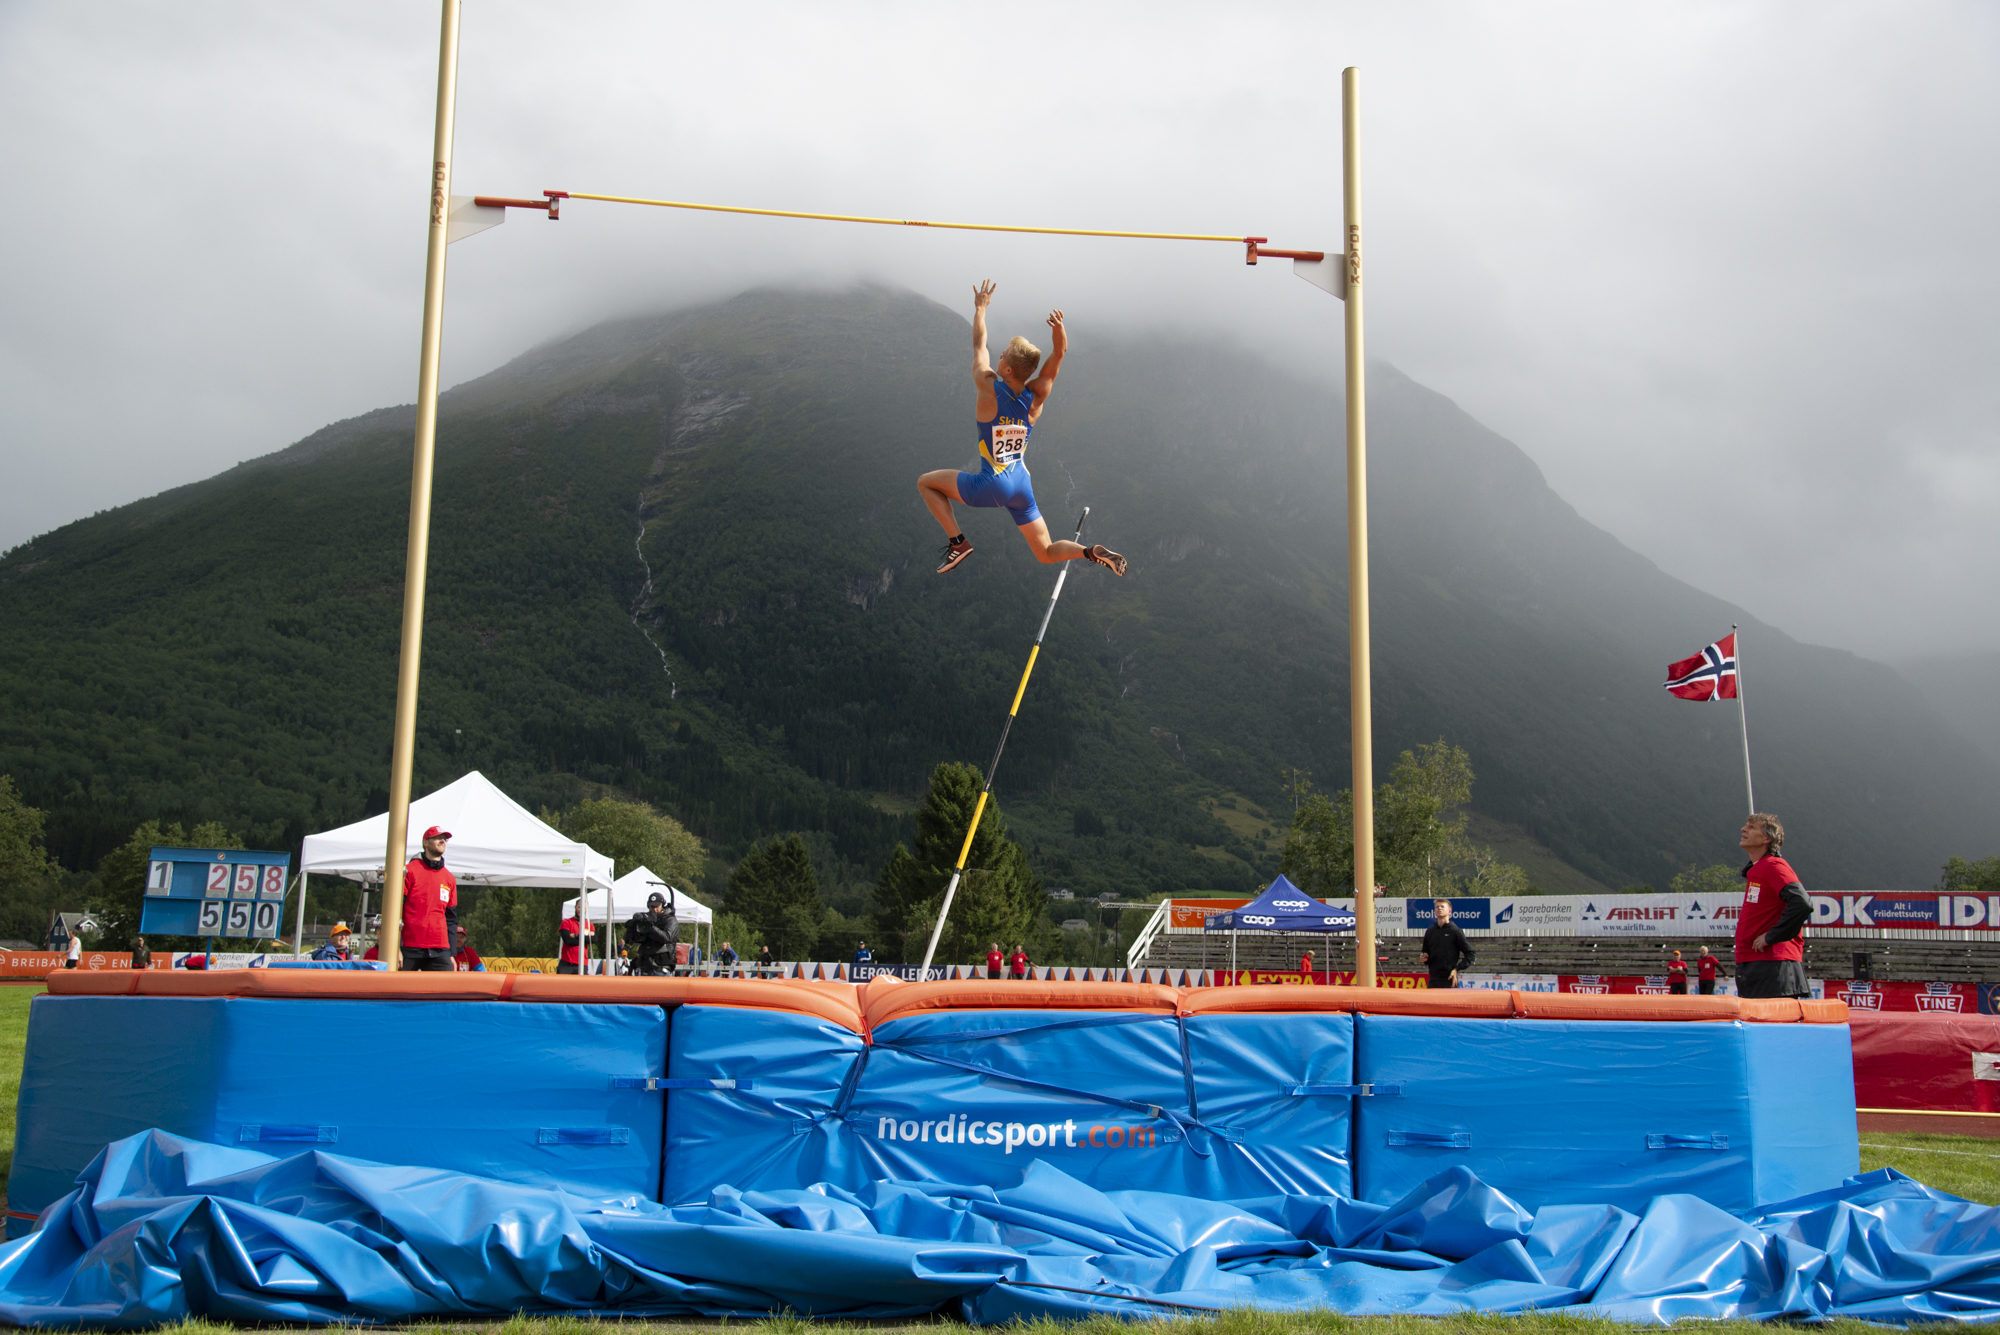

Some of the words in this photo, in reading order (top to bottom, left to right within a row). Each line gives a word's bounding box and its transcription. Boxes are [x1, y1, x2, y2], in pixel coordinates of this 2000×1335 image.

[995, 438, 1023, 455] 258
[154, 862, 169, 889] 1
[209, 865, 283, 892] 258
[1272, 900, 1310, 908] coop
[1519, 903, 1572, 914] sparebanken
[1894, 902, 1906, 911] Alt
[201, 901, 274, 929] 550
[1805, 895, 1876, 926] DK
[1242, 915, 1275, 926] coop
[1323, 916, 1356, 927] coop
[1543, 914, 1572, 925] fjordane
[1602, 923, 1656, 931] www.airlift.no
[11, 958, 68, 967] BREIBAN
[1574, 986, 1603, 994] TINE
[1842, 994, 1877, 1007] TINE
[1920, 997, 1957, 1010] TINE
[877, 1113, 1155, 1155] nordicsport.com
